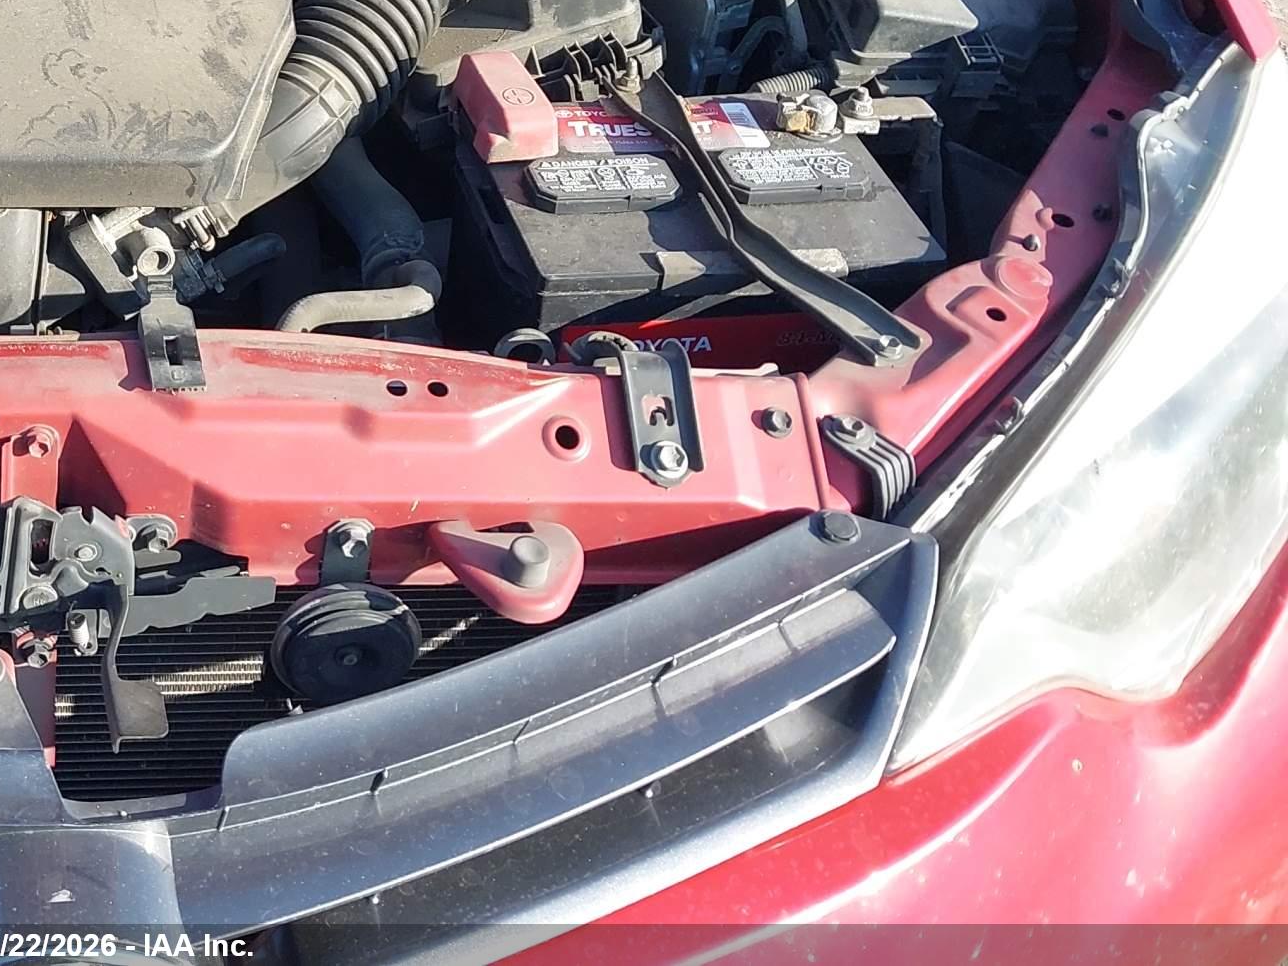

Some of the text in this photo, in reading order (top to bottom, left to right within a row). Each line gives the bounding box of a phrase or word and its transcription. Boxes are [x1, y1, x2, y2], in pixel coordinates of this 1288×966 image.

[574, 109, 608, 118] TOYO
[552, 159, 597, 168] DANGER
[609, 156, 649, 166] POISON
[633, 336, 713, 352] OYTA
